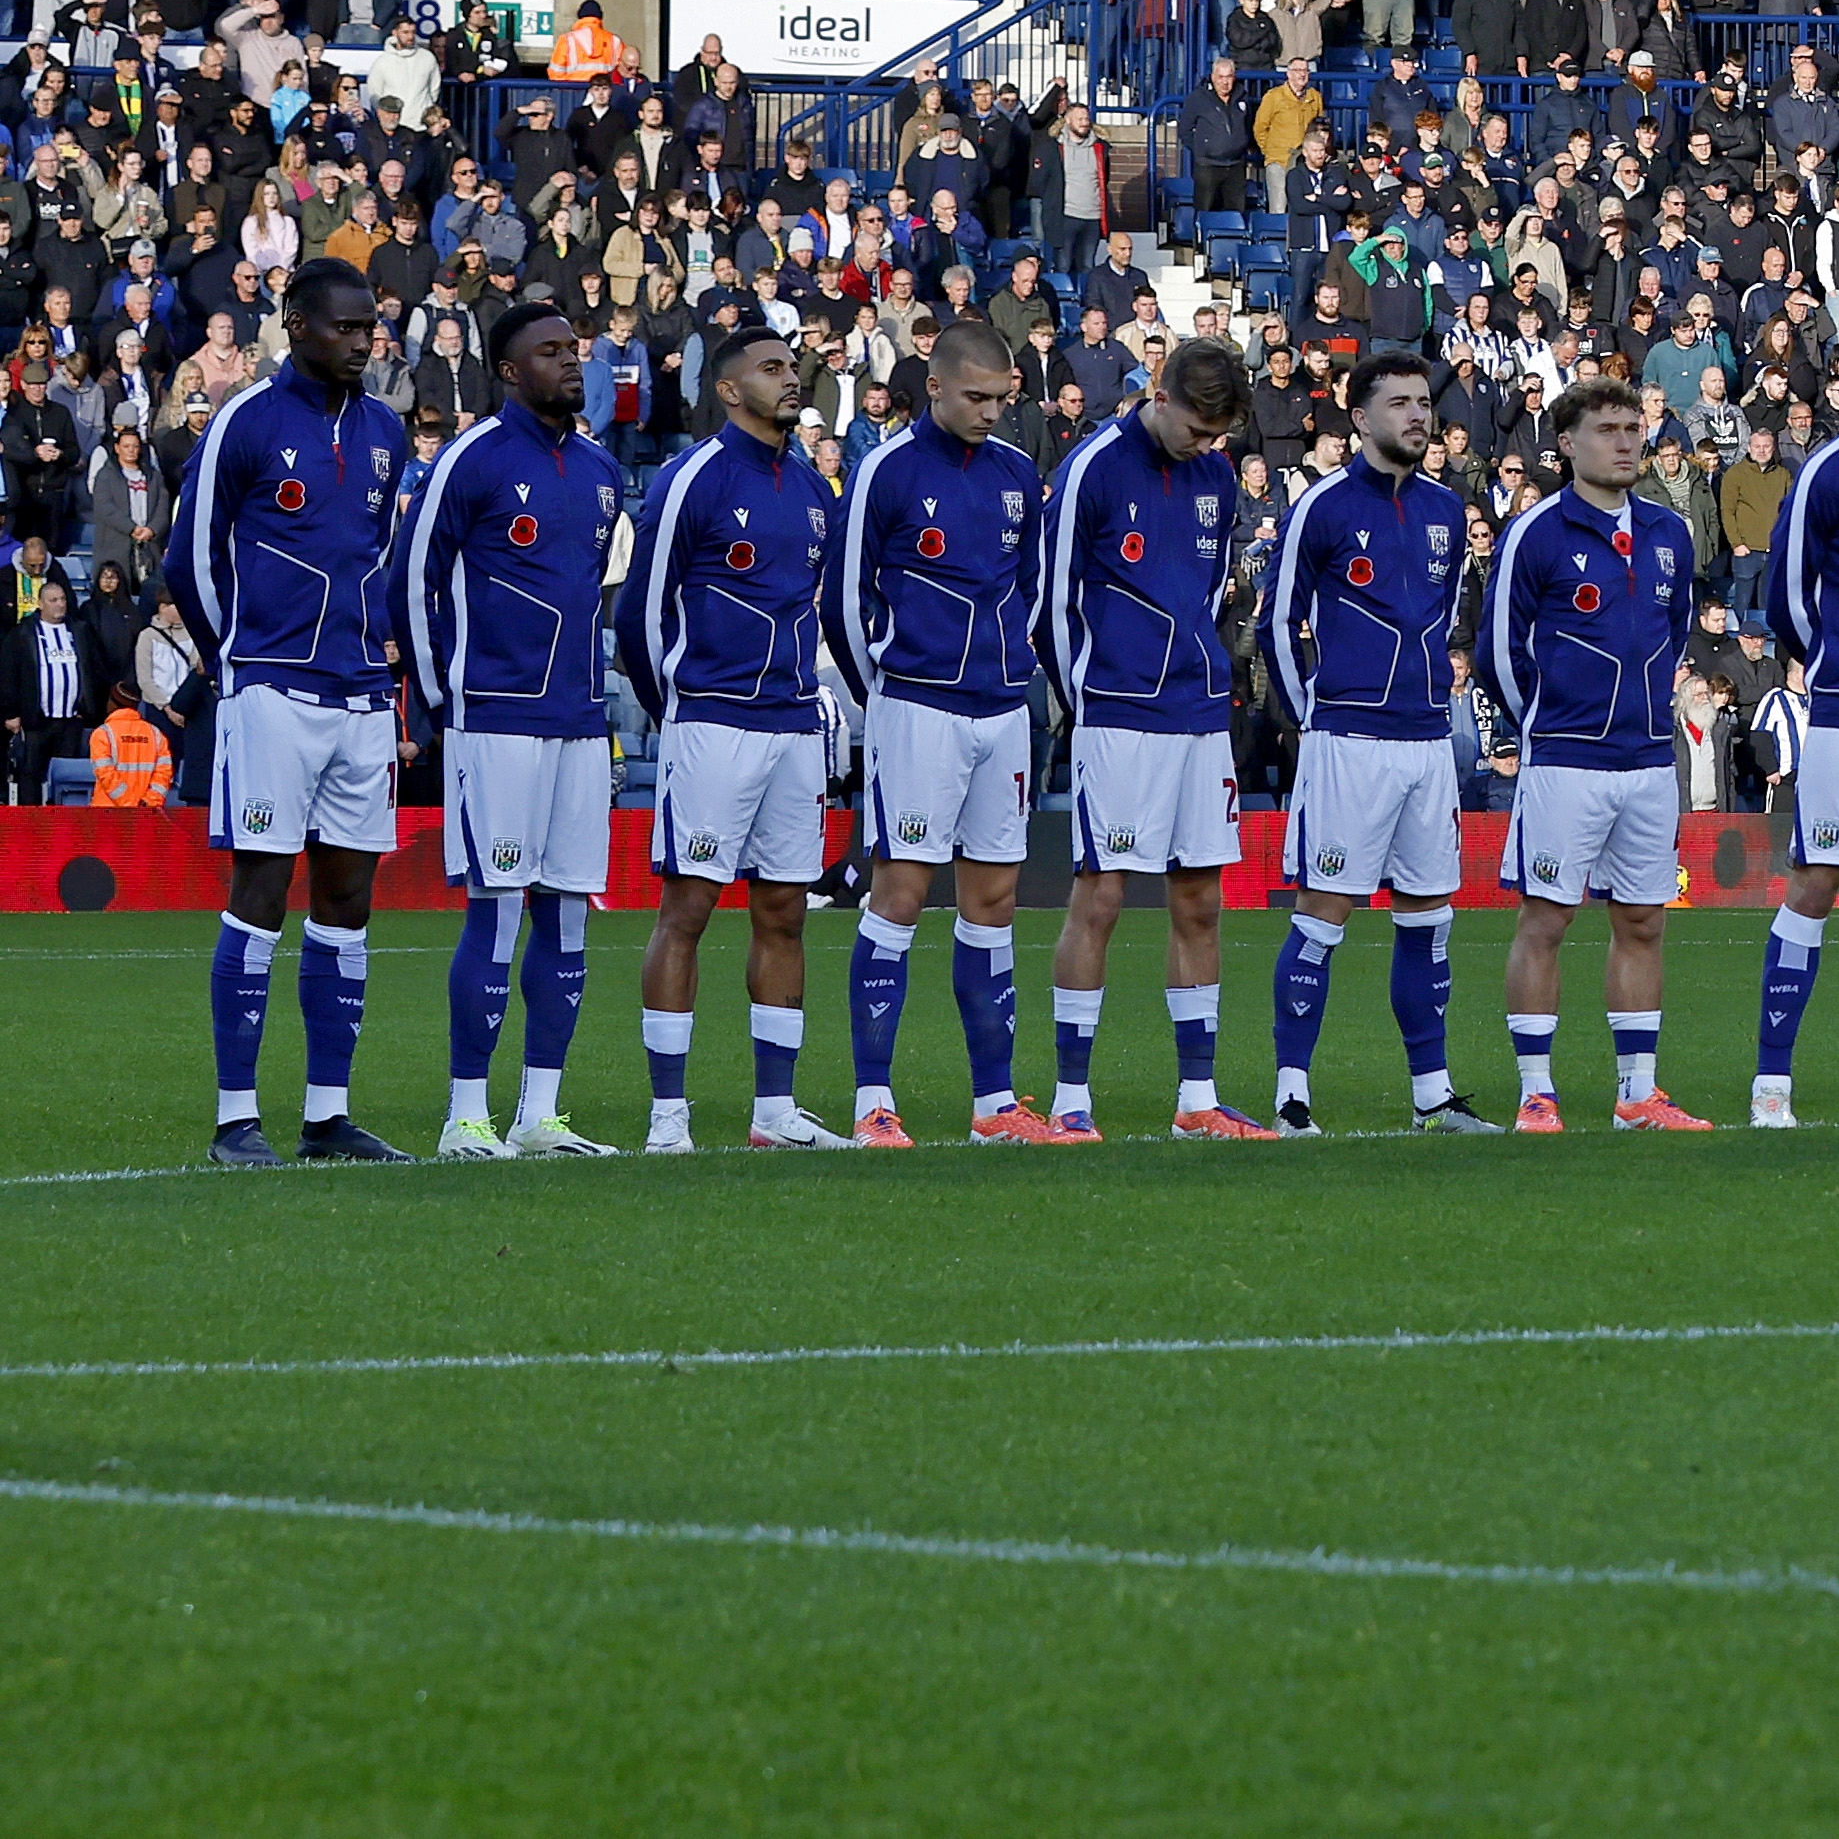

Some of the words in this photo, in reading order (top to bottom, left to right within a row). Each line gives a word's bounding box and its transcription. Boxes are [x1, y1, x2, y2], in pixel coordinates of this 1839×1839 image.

[779, 5, 871, 42] ideal
[788, 46, 861, 58] HEATING
[121, 735, 148, 743] STEWARD
[1013, 770, 1025, 817] 1
[863, 978, 896, 988] WBA
[1289, 974, 1319, 987] WBA
[1769, 984, 1799, 994] WBA
